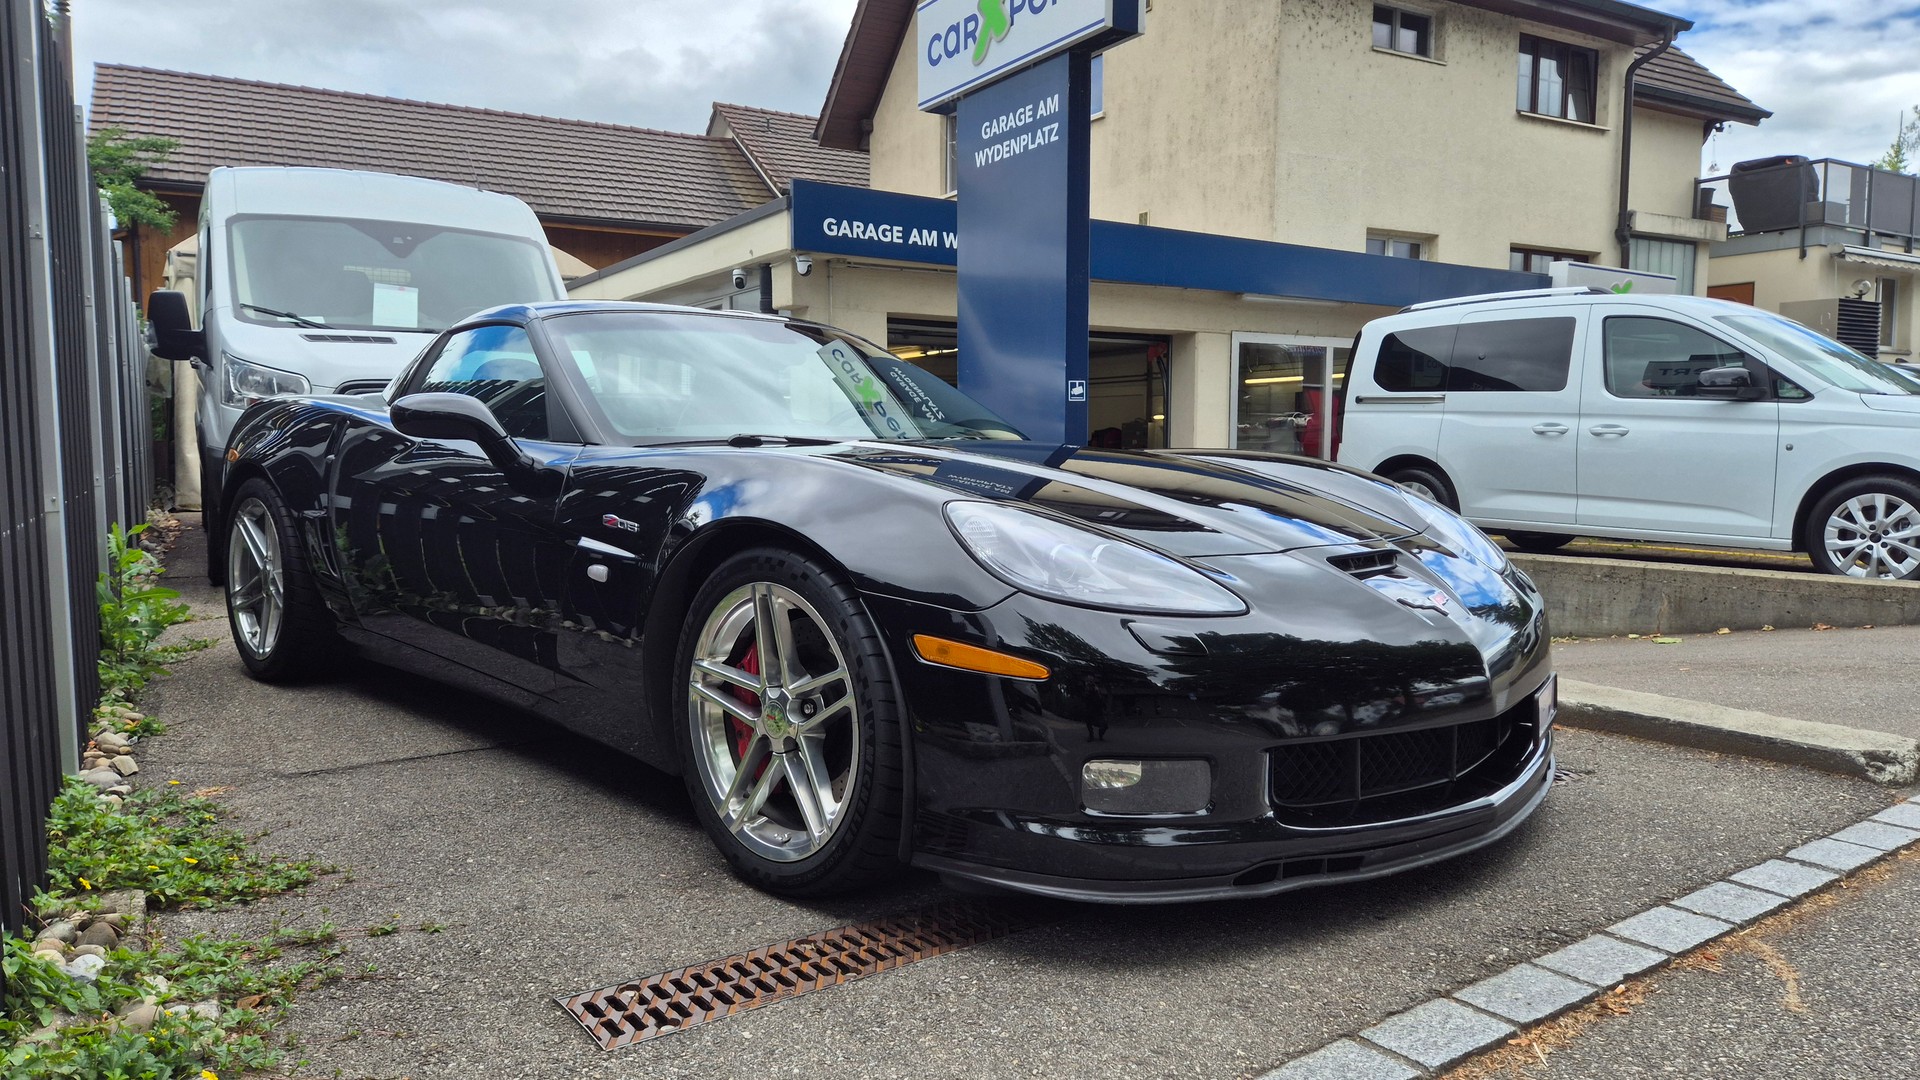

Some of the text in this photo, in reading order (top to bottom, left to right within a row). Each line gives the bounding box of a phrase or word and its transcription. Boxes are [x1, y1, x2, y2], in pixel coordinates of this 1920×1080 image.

[981, 94, 1059, 140] GARAGE AM
[974, 122, 1059, 168] WYDENPLATZ
[823, 217, 903, 243] GARAGE
[908, 227, 938, 247] AM
